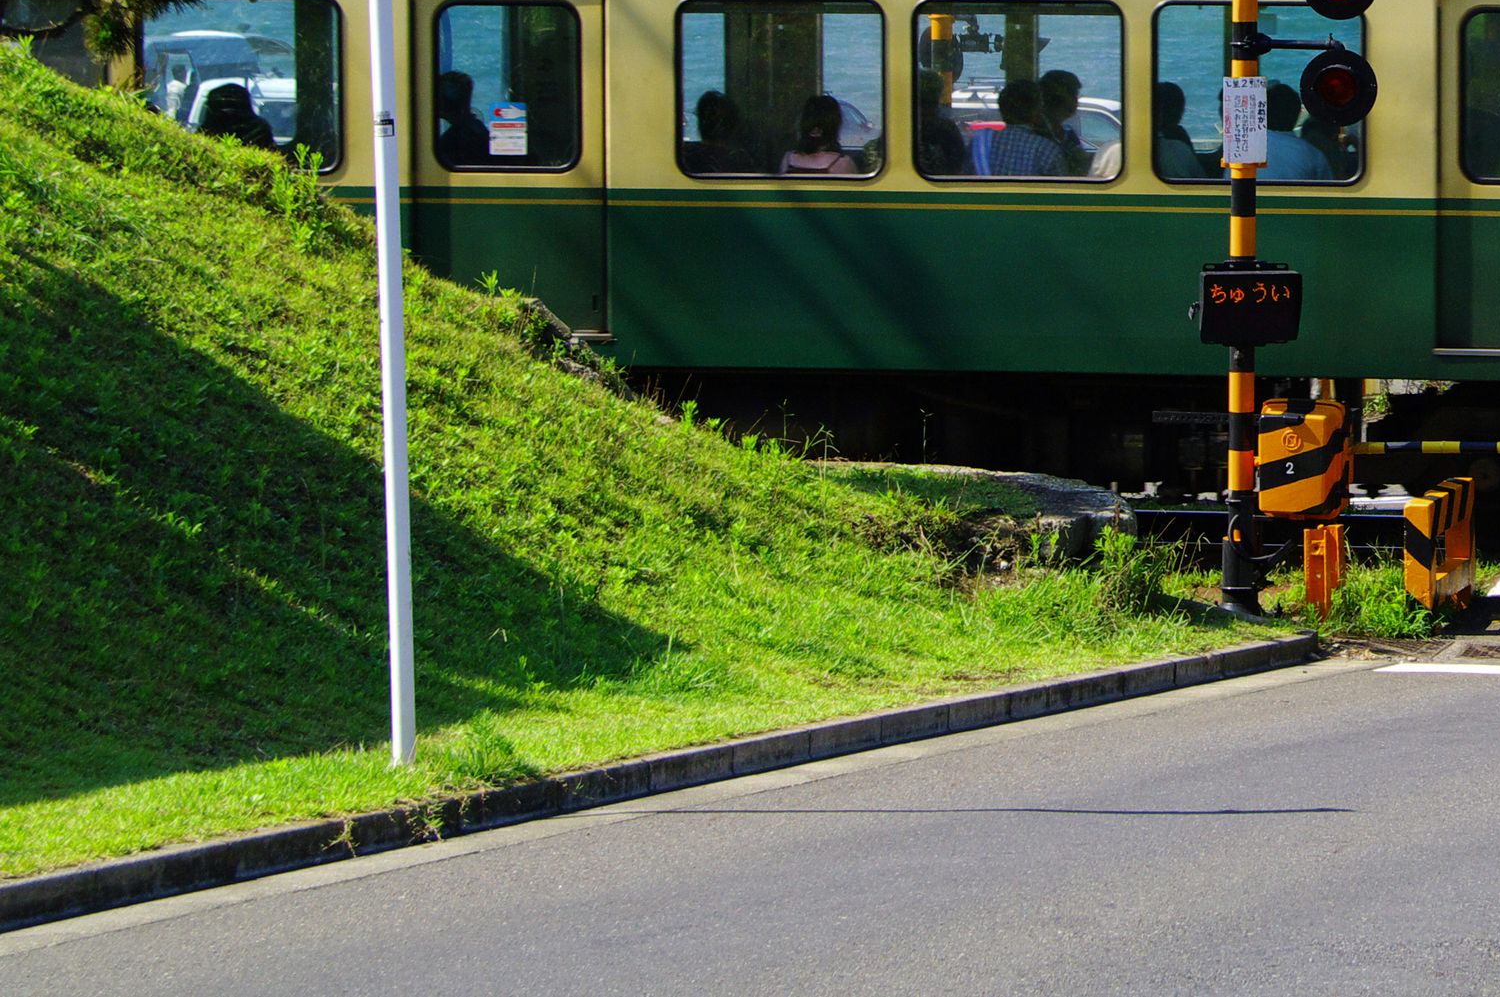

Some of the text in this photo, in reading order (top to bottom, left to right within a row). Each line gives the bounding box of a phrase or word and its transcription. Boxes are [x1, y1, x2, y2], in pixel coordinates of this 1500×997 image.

[1257, 100, 1266, 130] おねがい
[1209, 282, 1291, 304] ちゅうい
[1285, 461, 1295, 475] 2
